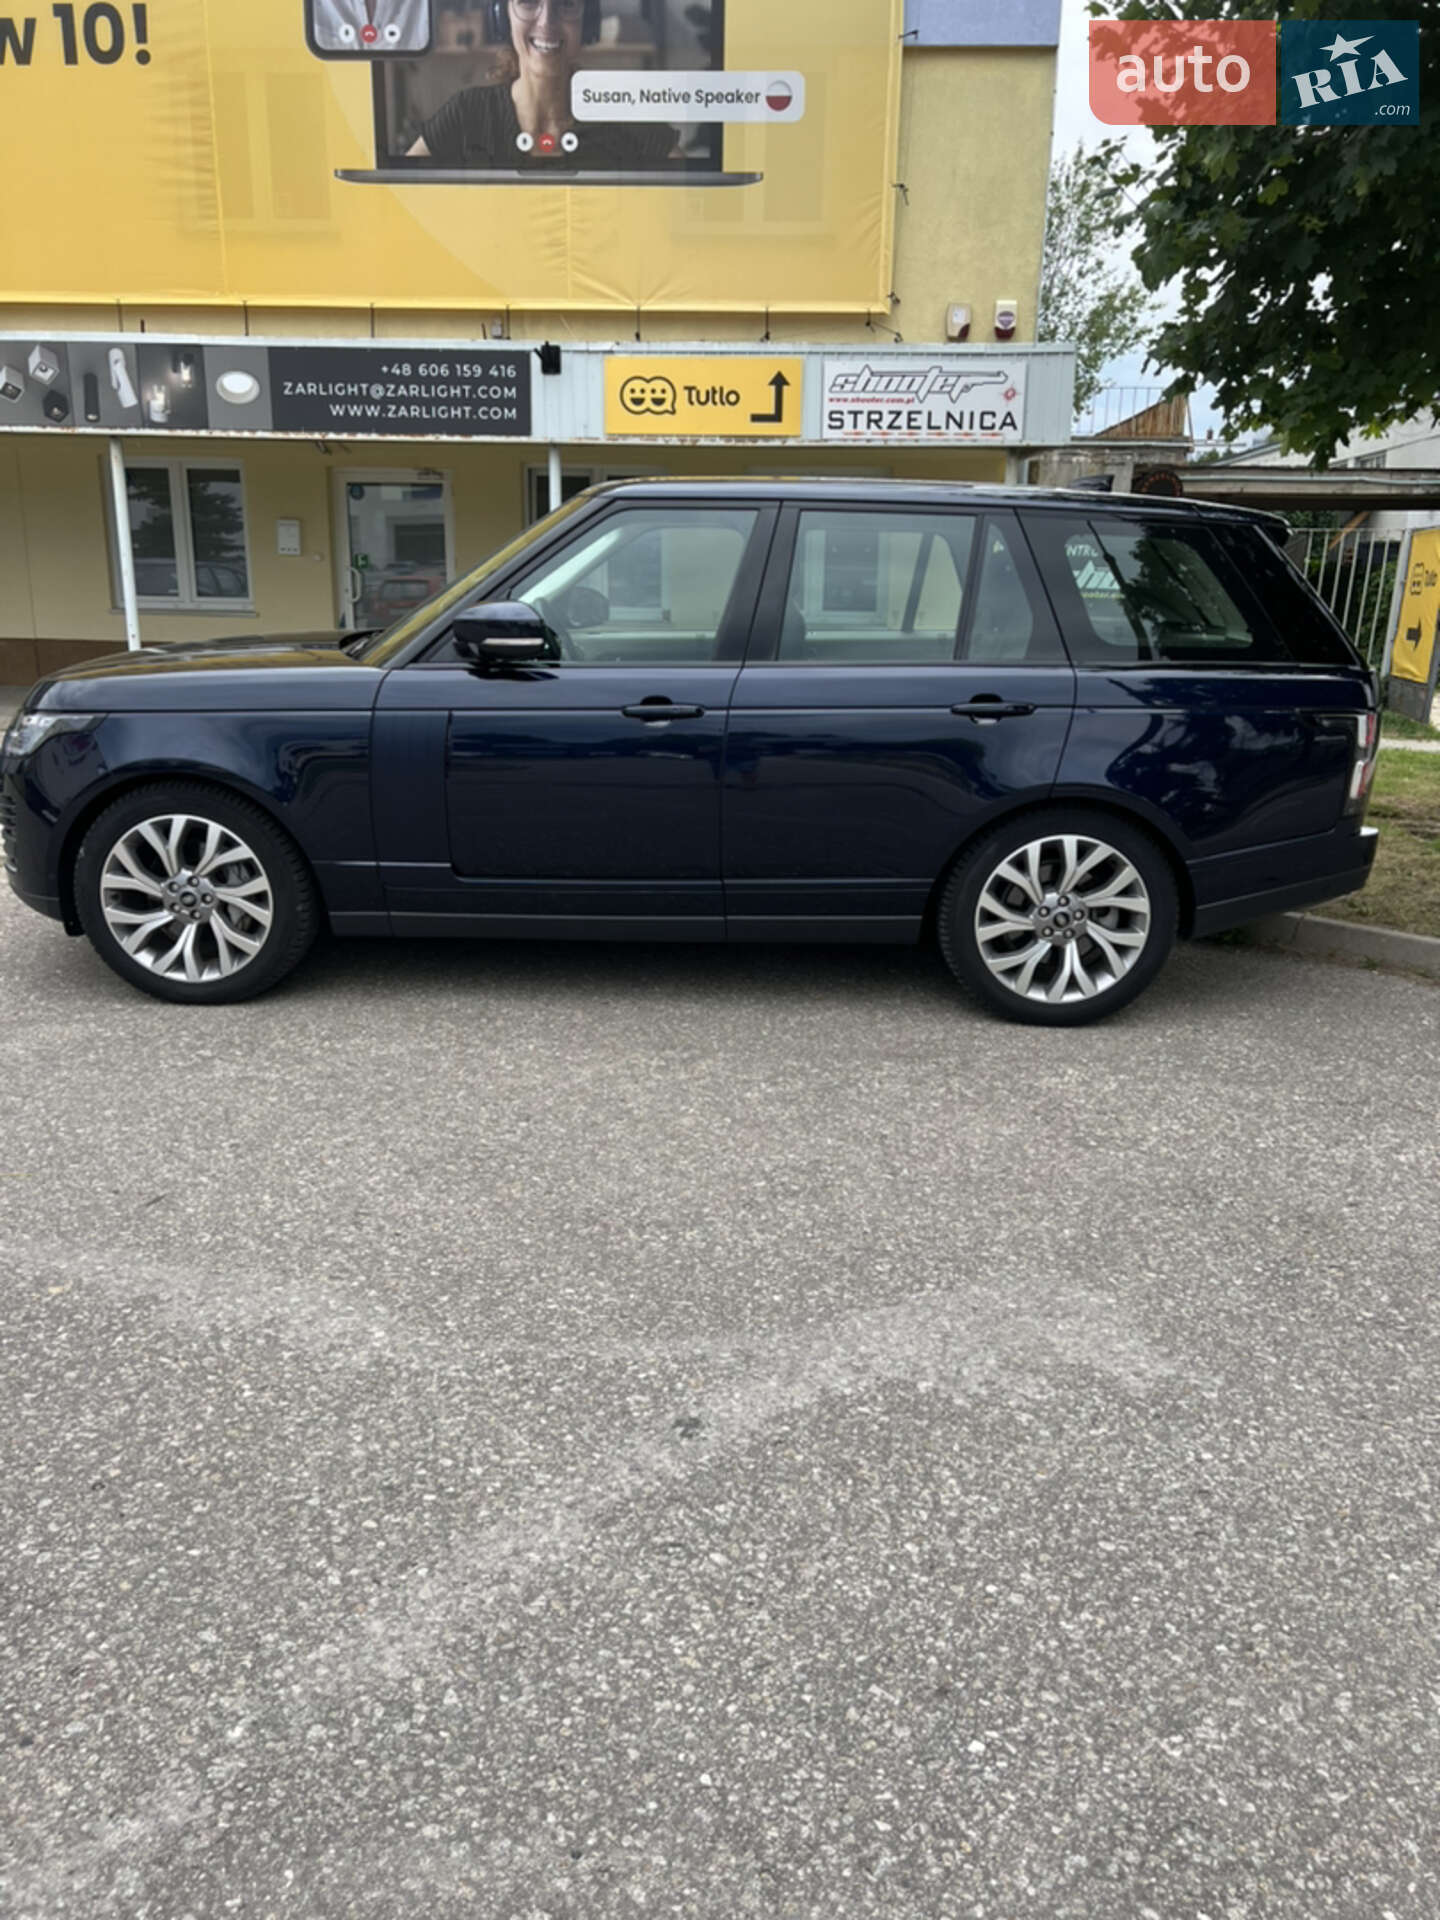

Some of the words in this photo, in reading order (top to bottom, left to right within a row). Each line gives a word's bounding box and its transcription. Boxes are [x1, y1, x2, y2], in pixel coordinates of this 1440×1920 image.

[52, 2, 151, 66] 10!
[582, 89, 636, 105] Susan,
[639, 88, 691, 104] Native
[695, 88, 761, 108] Speaker
[381, 363, 412, 376] +48
[418, 364, 450, 377] 606
[455, 364, 482, 378] 159
[489, 365, 517, 378] 416
[283, 381, 517, 400] ZARLIGHT@ZARLIGHT.COM
[683, 385, 740, 406] Tutlo
[329, 404, 517, 420] WWW.ZARLIGHT.COM
[828, 410, 1018, 431] STRZELNICA
